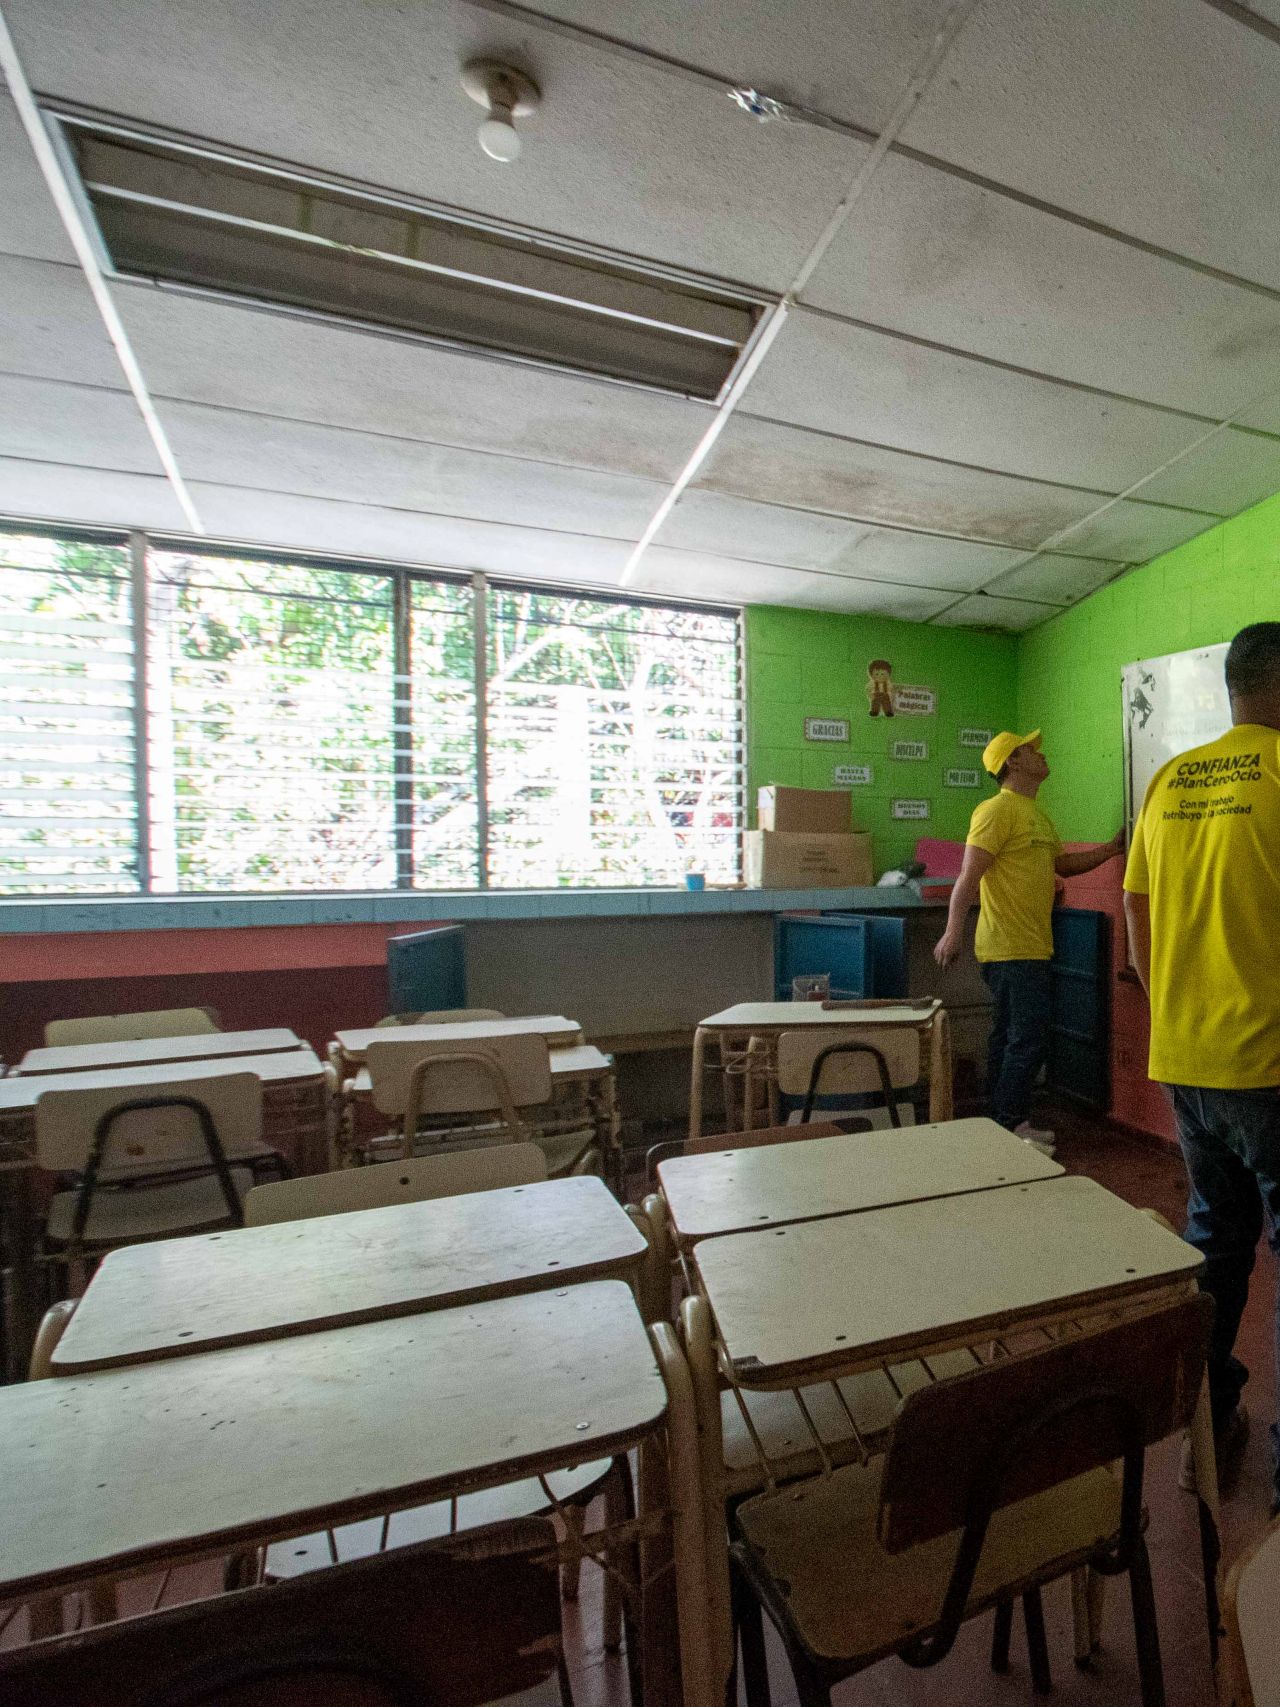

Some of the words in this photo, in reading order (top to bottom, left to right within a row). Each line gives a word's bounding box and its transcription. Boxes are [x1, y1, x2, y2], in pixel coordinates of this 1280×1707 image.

[1176, 752, 1261, 777] CONFIANZA
[1166, 767, 1262, 789] #PlanCeroOcio
[1179, 799, 1197, 809] Con
[1163, 810, 1202, 823] Retribuyo
